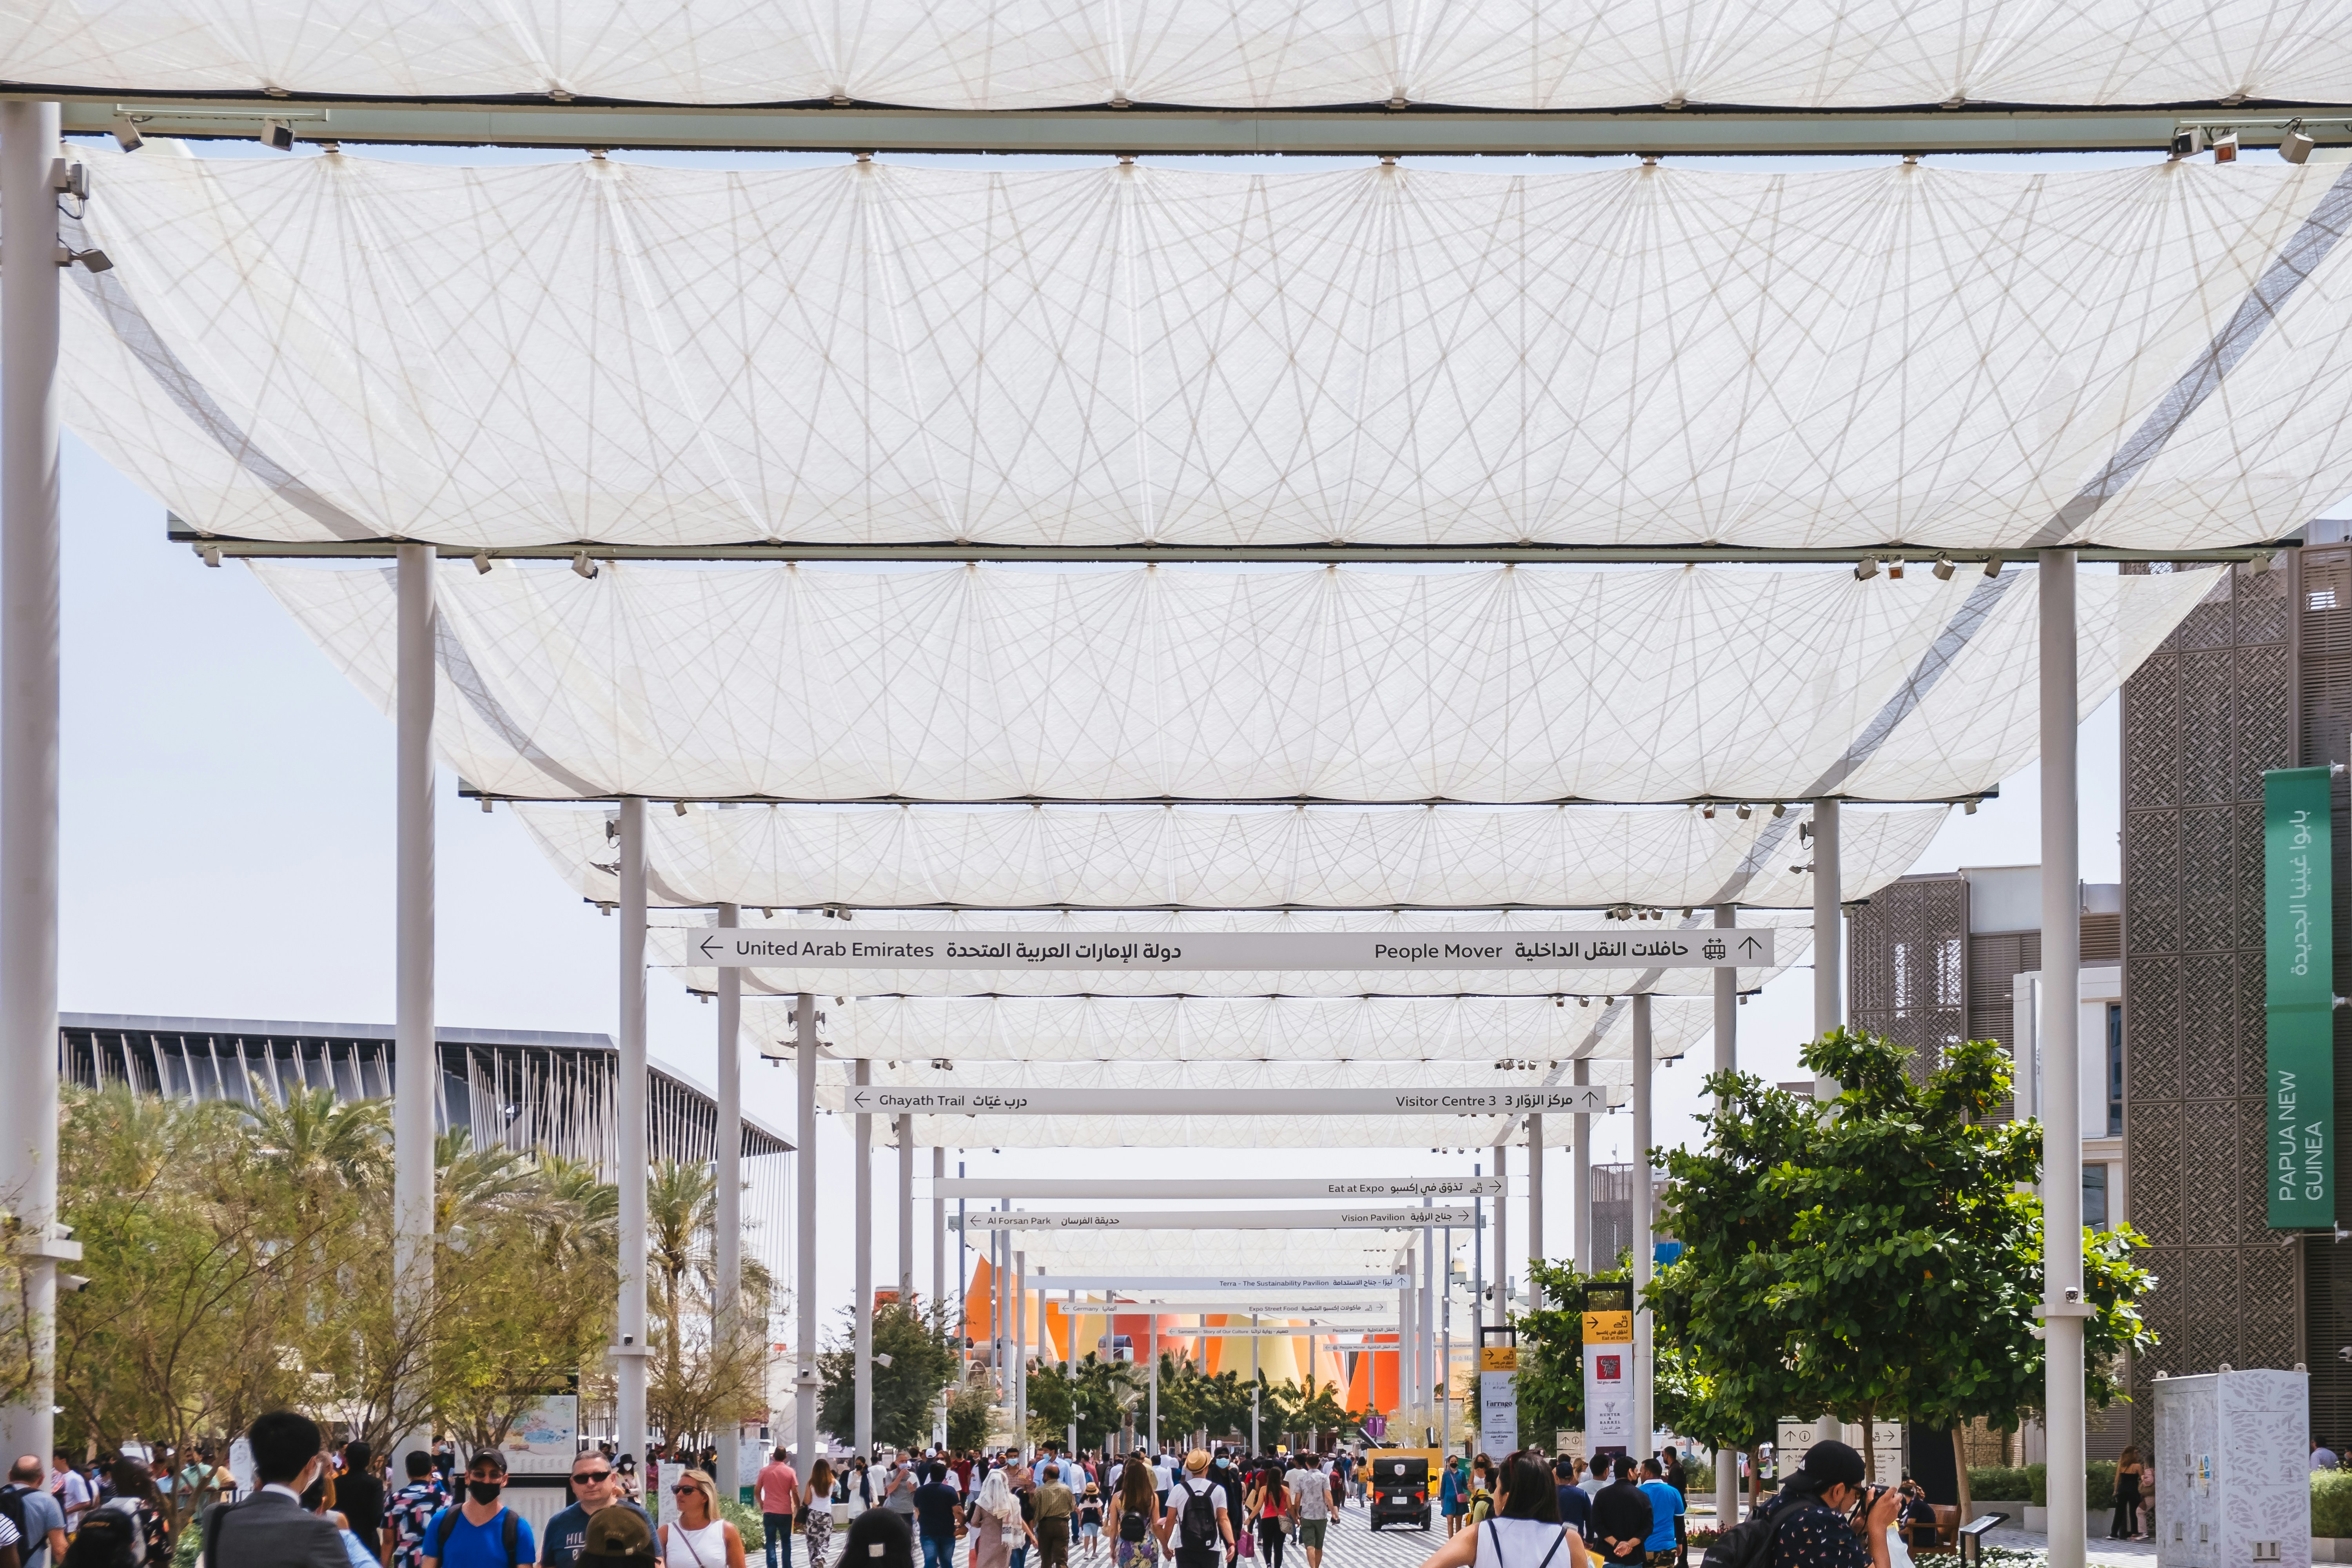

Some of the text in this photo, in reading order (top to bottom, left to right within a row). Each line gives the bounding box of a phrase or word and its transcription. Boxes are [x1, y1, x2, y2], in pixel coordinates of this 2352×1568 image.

[2288, 809, 2313, 976] بابوا غينيا الجديدة
[737, 940, 933, 957] United Arab Emirates
[947, 942, 1181, 963] دولة الإمارات العربية المتحدة
[1376, 944, 1503, 962] People Mover
[1515, 941, 1688, 962] حافلات النقل الداخلية
[880, 1095, 964, 1108] Ghayath Trail
[1005, 1099, 1027, 1109] درب
[1396, 1096, 1495, 1106] Visitor Centre 3
[1505, 1096, 1512, 1105] 3
[1547, 1094, 1572, 1107] مركز
[2278, 1070, 2296, 1200] PAPUA NEW
[2305, 1121, 2324, 1200] GUINEA
[1360, 1185, 1384, 1194] Expo
[1391, 1183, 1417, 1194] إكسبو
[1421, 1183, 1436, 1196] في
[1062, 1217, 1119, 1226] حديقة الفرسان
[1411, 1212, 1452, 1222] جناح الرؤية
